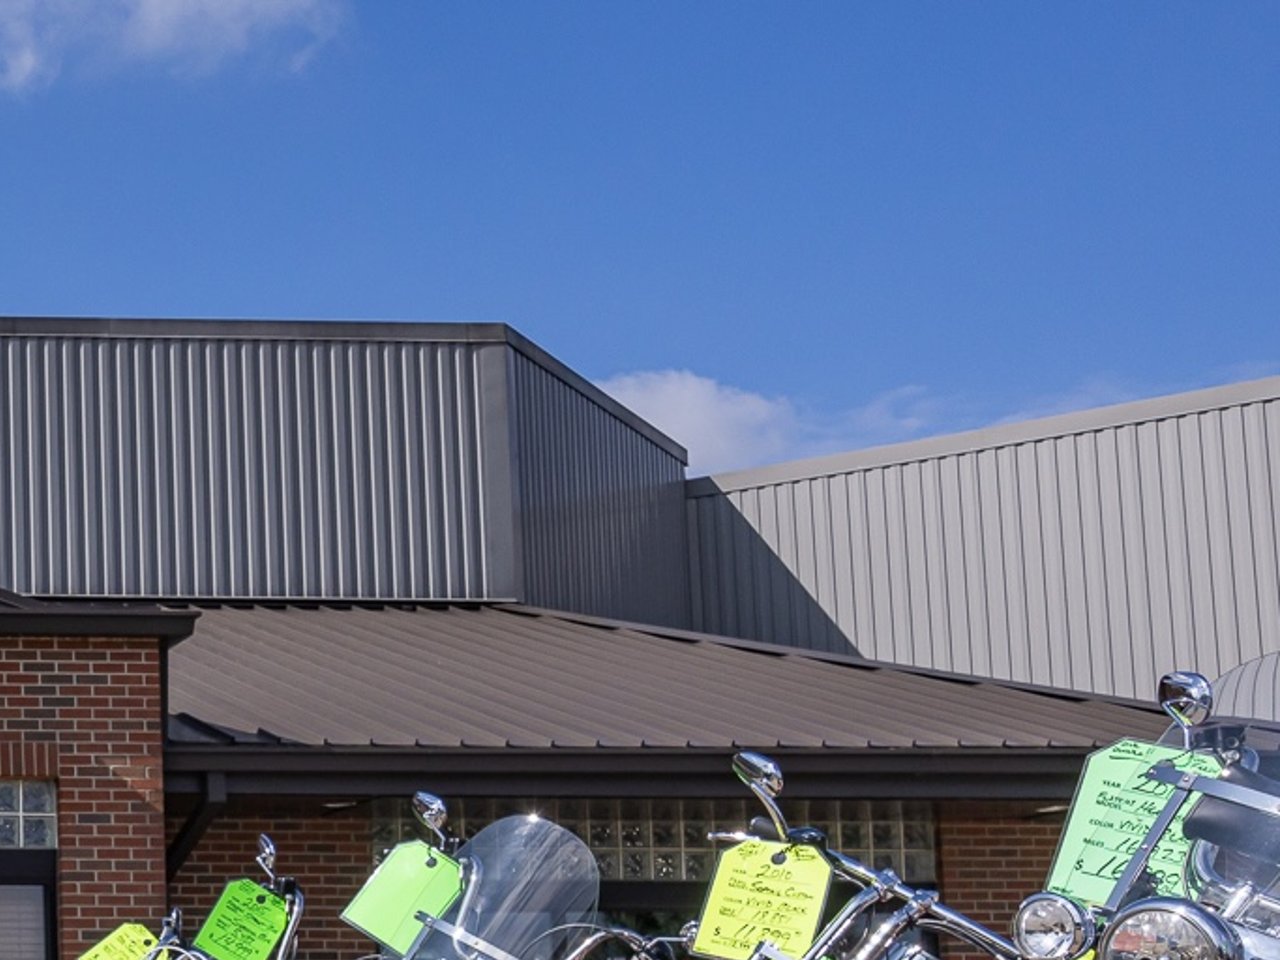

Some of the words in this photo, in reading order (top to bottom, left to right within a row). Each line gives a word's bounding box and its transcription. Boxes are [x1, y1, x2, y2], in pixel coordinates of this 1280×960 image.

[1102, 780, 1122, 789] YEAR
[1089, 818, 1115, 829] COLOR
[1074, 859, 1084, 871] $
[756, 864, 793, 880] 2010
